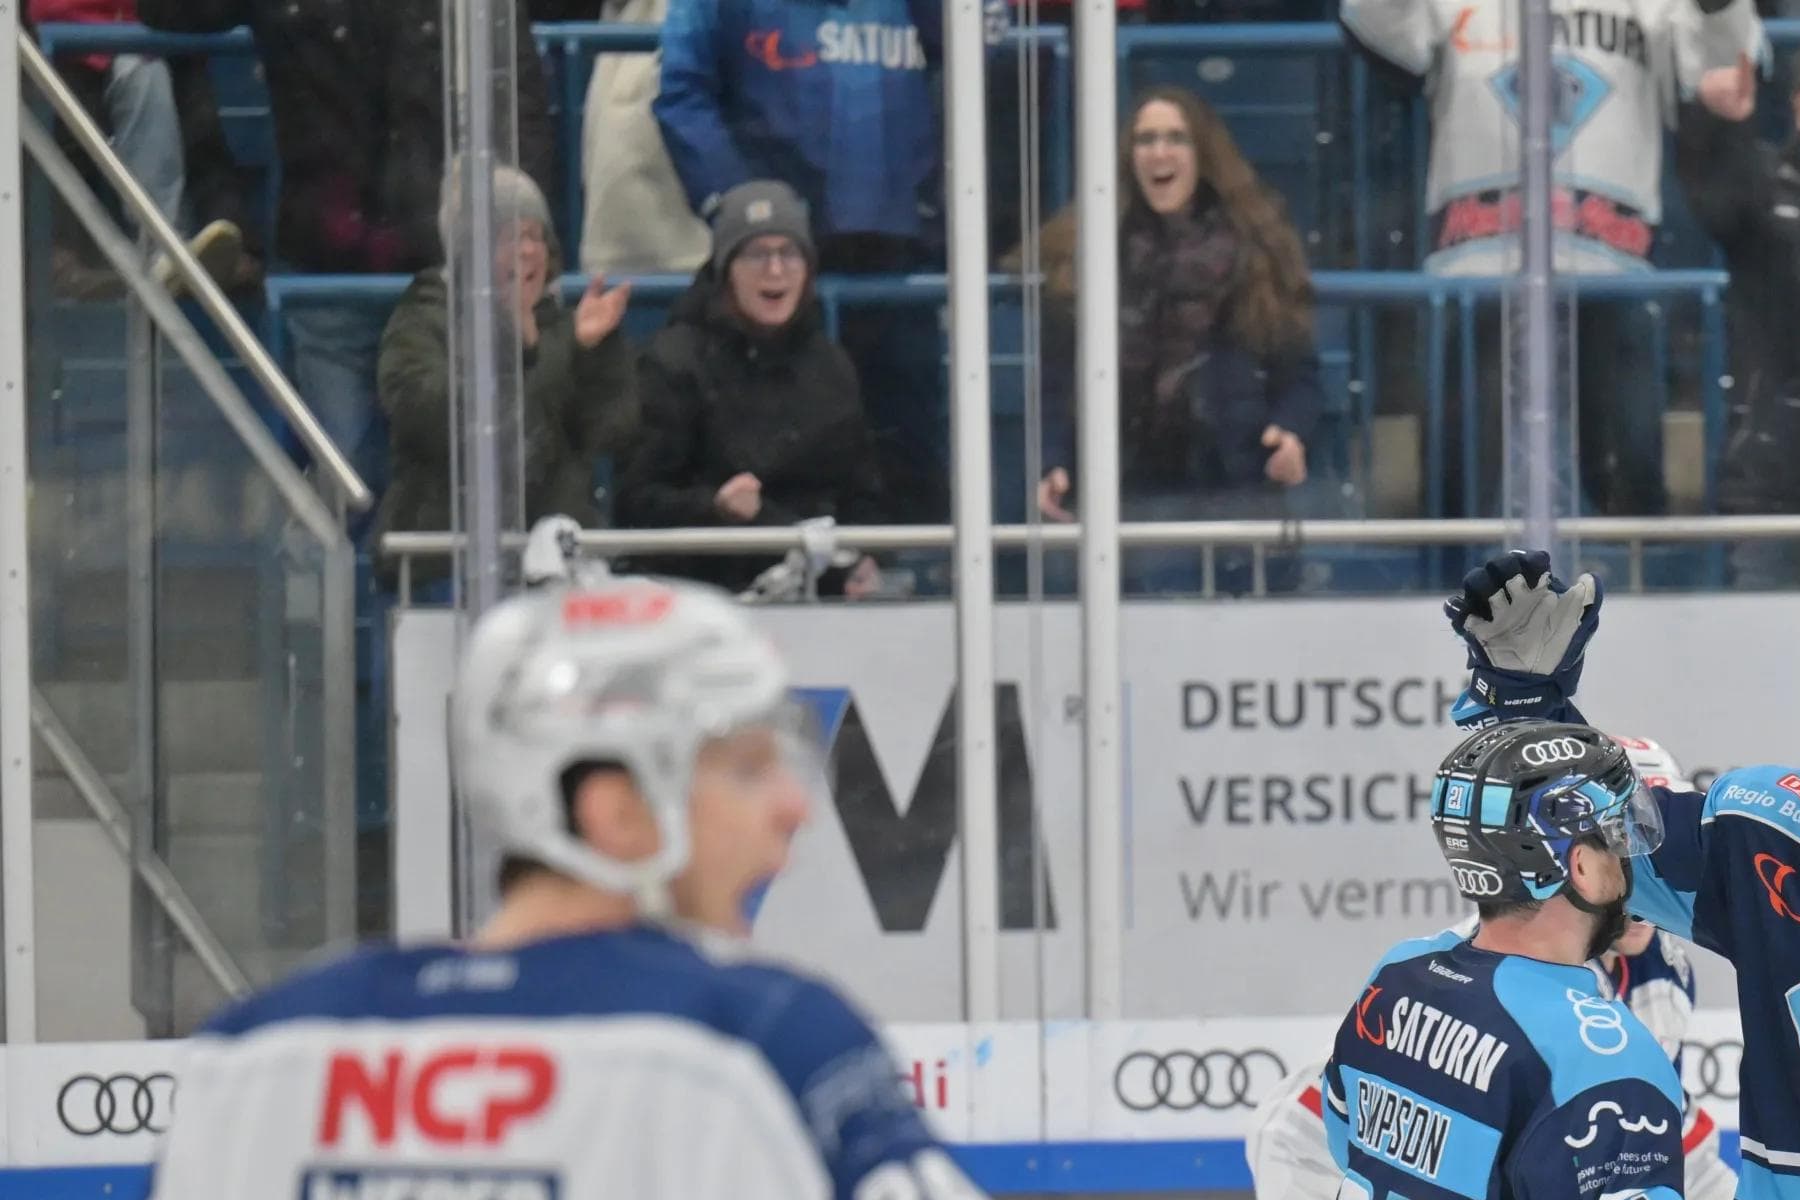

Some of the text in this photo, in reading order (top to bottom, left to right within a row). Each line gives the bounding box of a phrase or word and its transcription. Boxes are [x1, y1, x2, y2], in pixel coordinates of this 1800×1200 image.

[1447, 785, 1464, 811] 21
[1722, 784, 1776, 807] Regio
[1445, 837, 1469, 848] ERC
[1180, 873, 1270, 924] Wir
[1386, 996, 1510, 1093] SATURN
[318, 1045, 558, 1148] NCP
